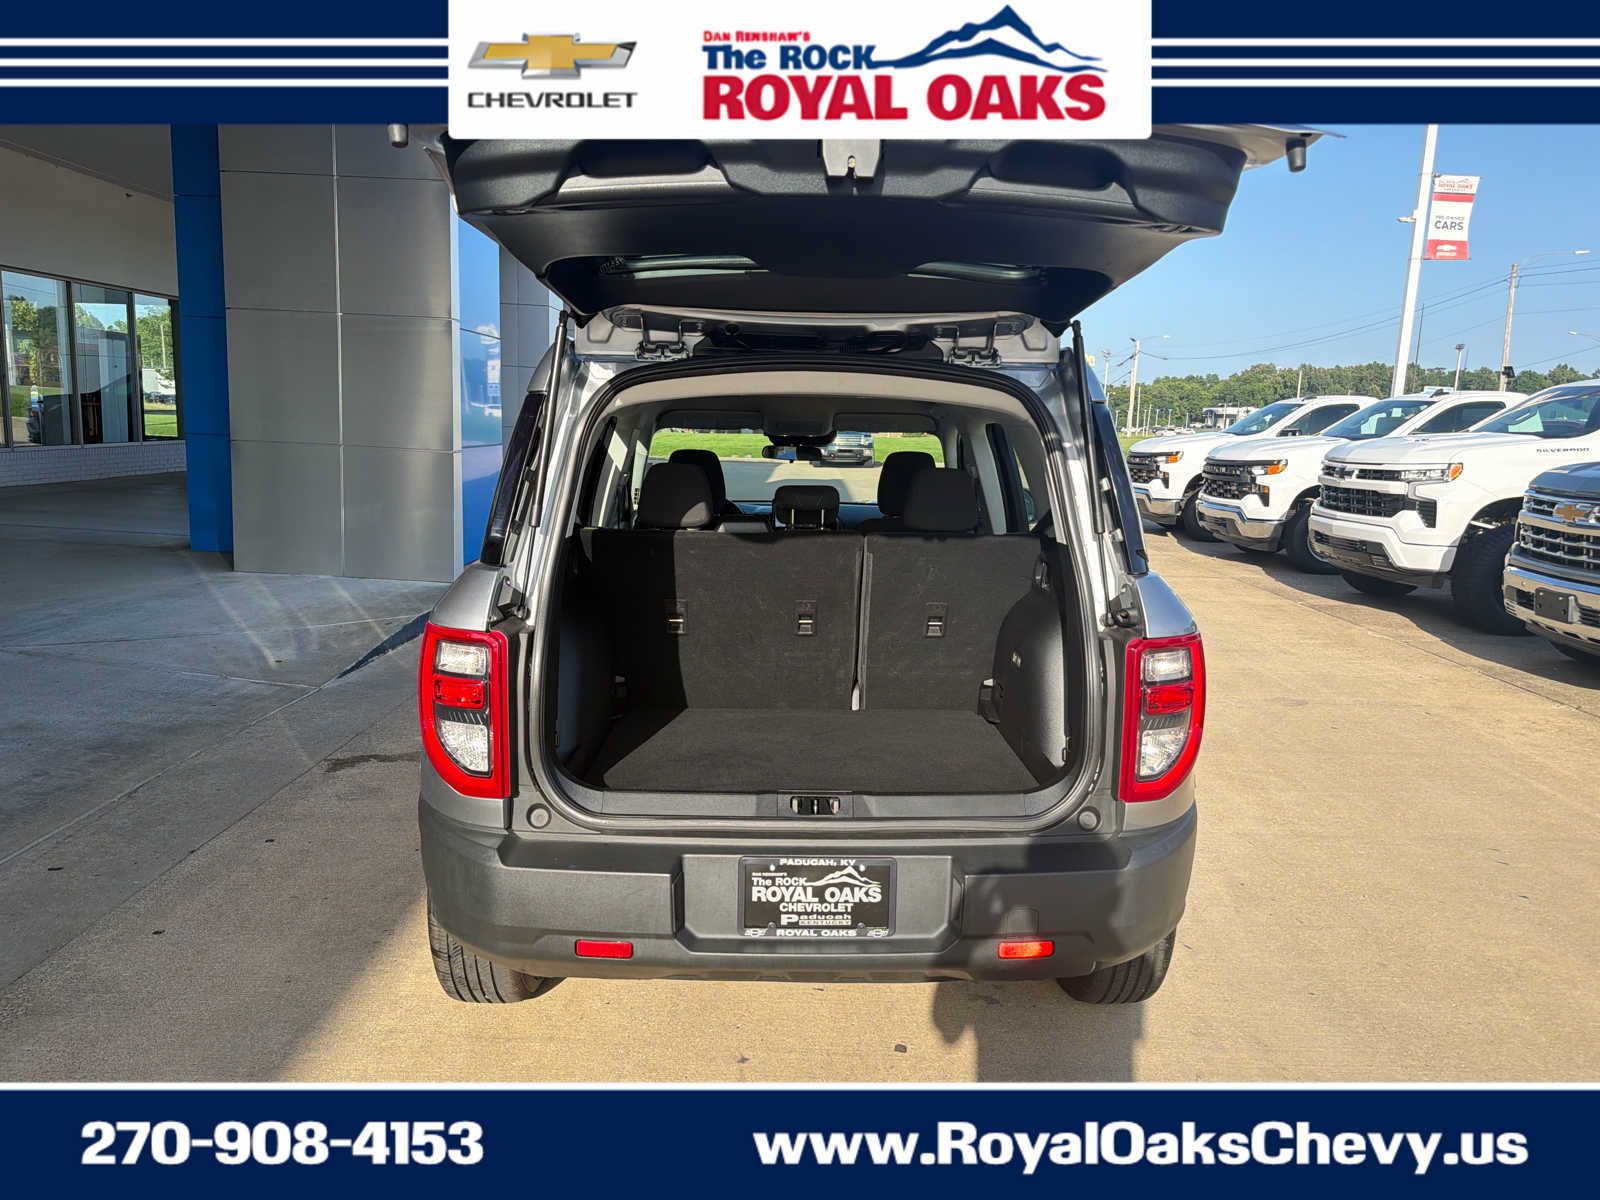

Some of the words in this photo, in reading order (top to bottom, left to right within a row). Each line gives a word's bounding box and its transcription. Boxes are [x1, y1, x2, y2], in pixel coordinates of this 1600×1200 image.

[1434, 220, 1464, 231] CARS
[840, 859, 856, 867] KY
[752, 877, 772, 886] The
[775, 877, 807, 886] ROCK
[751, 886, 819, 902] ROYAL
[824, 886, 882, 902] OAKS
[779, 902, 854, 913] CHEVROLET
[776, 928, 818, 937] ROYAL
[820, 928, 857, 937] OAKS
